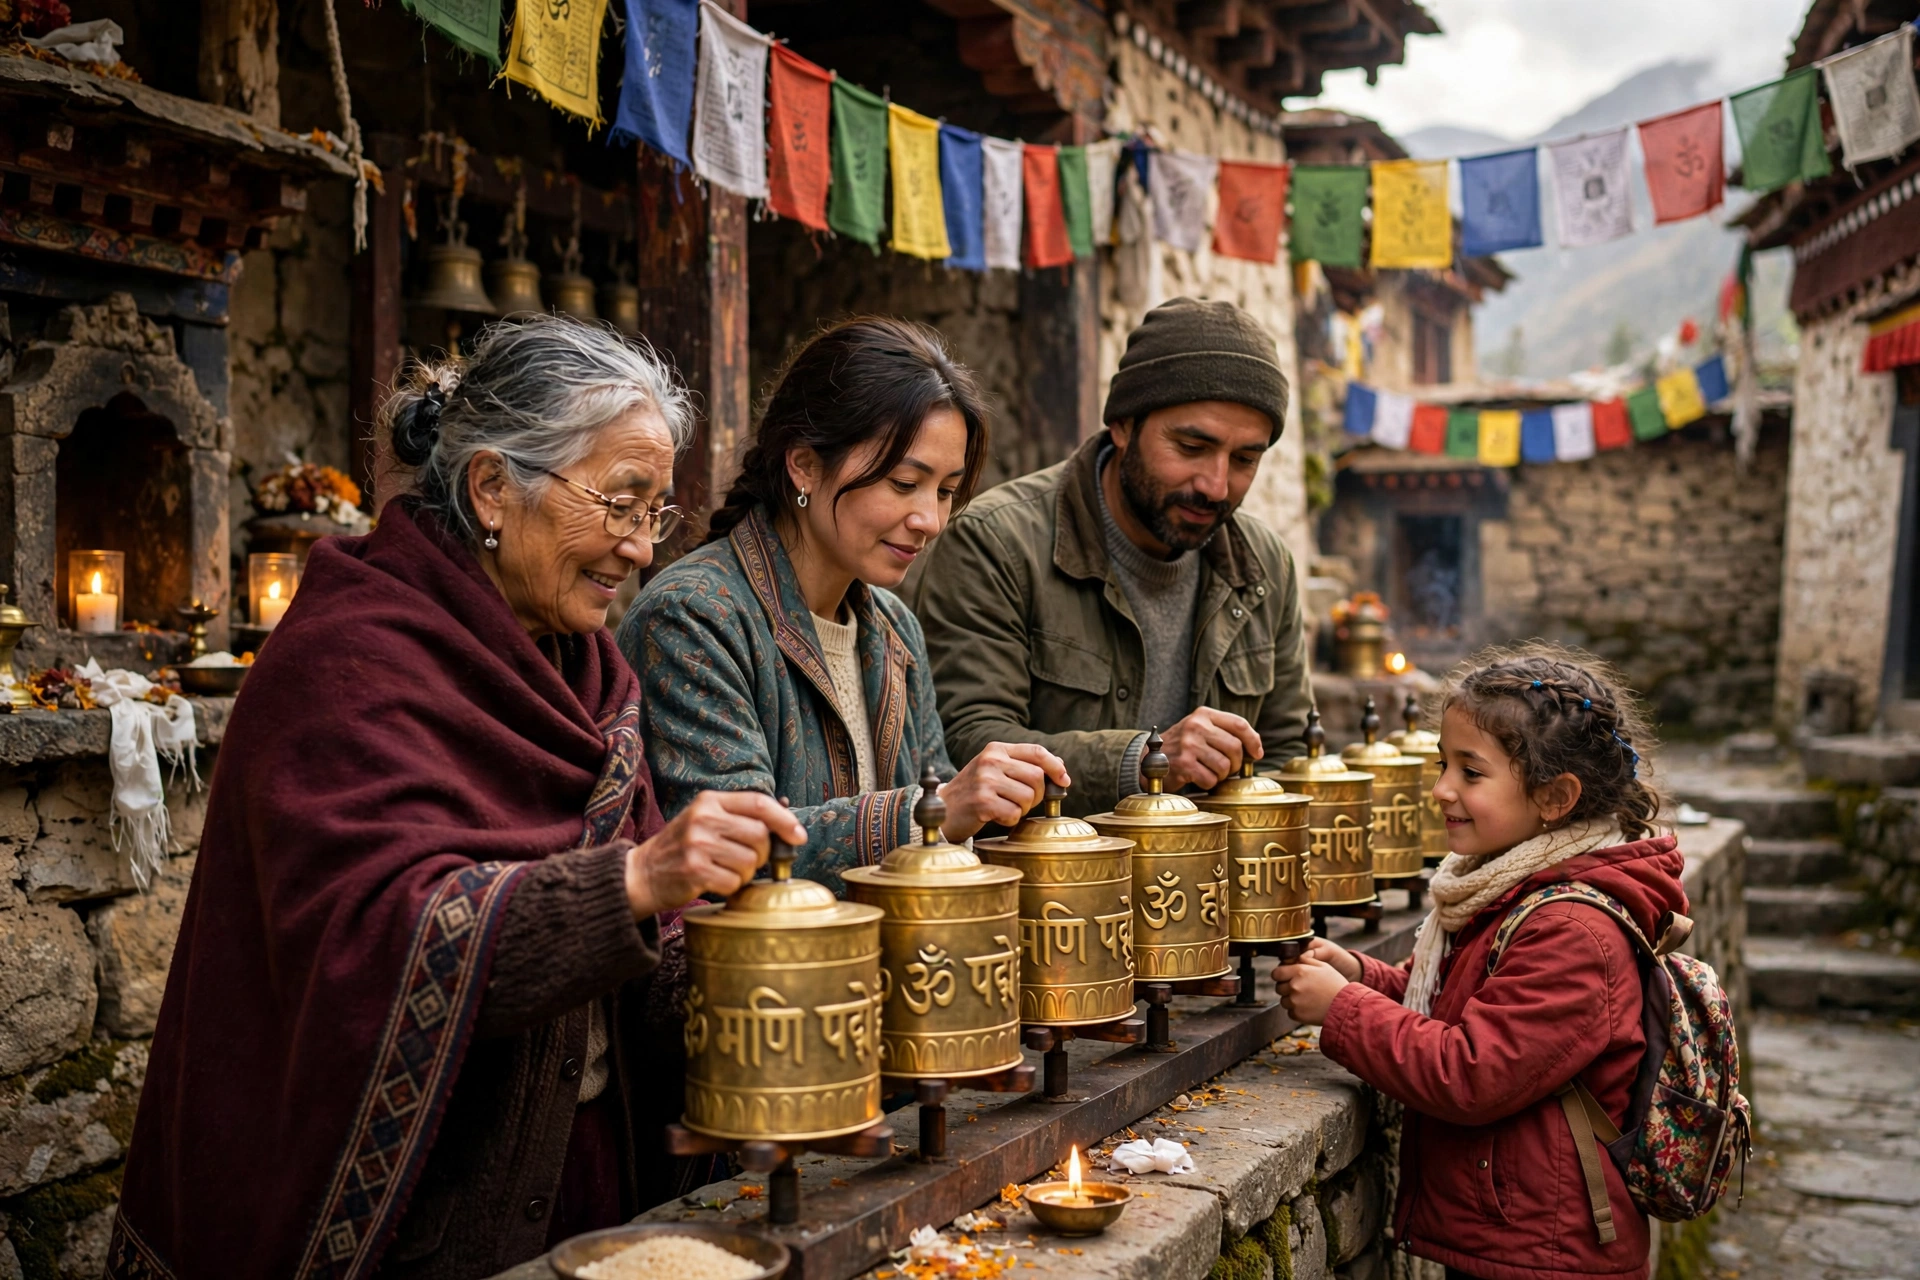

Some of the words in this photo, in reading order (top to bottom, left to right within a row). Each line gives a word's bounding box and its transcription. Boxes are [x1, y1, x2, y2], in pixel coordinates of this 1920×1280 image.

[1019, 901, 1088, 967] मणि
[1140, 870, 1188, 930] ॐ
[901, 943, 956, 1015] ॐ
[713, 986, 806, 1067] मणि
